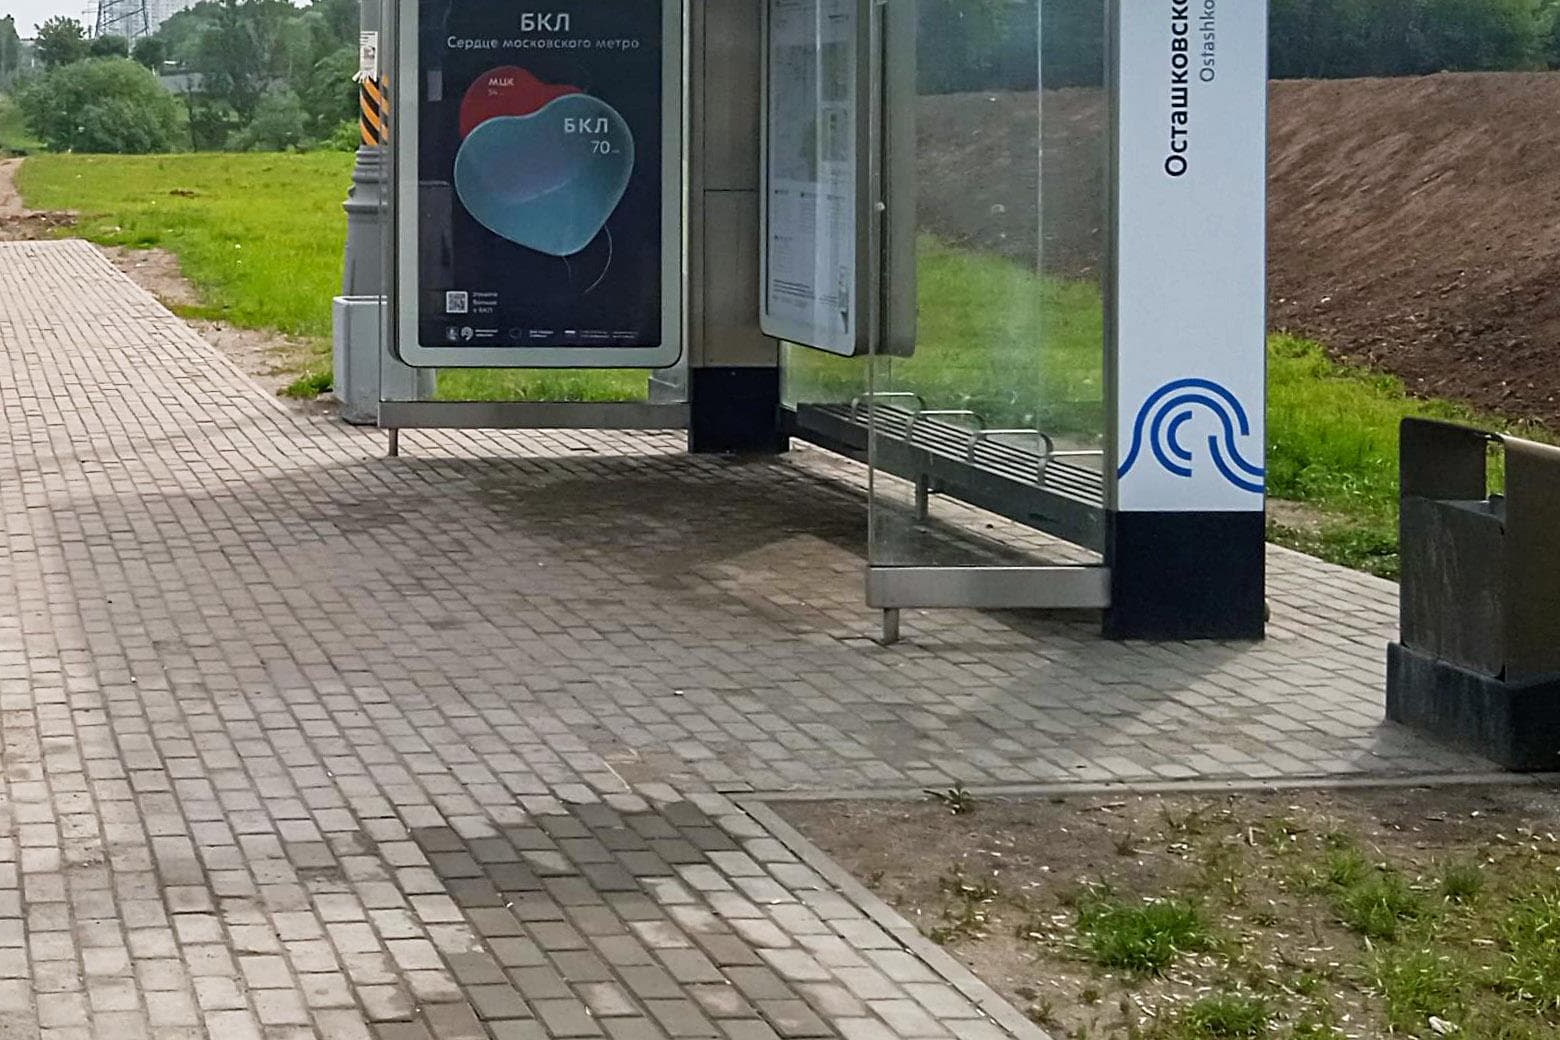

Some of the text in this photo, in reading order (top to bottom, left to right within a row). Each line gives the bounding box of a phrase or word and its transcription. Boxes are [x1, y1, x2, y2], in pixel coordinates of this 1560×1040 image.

[521, 13, 570, 32] БКЛ
[447, 36, 640, 50] Сердце московского метро
[564, 118, 608, 134] БКЛ
[590, 140, 611, 154] 70
